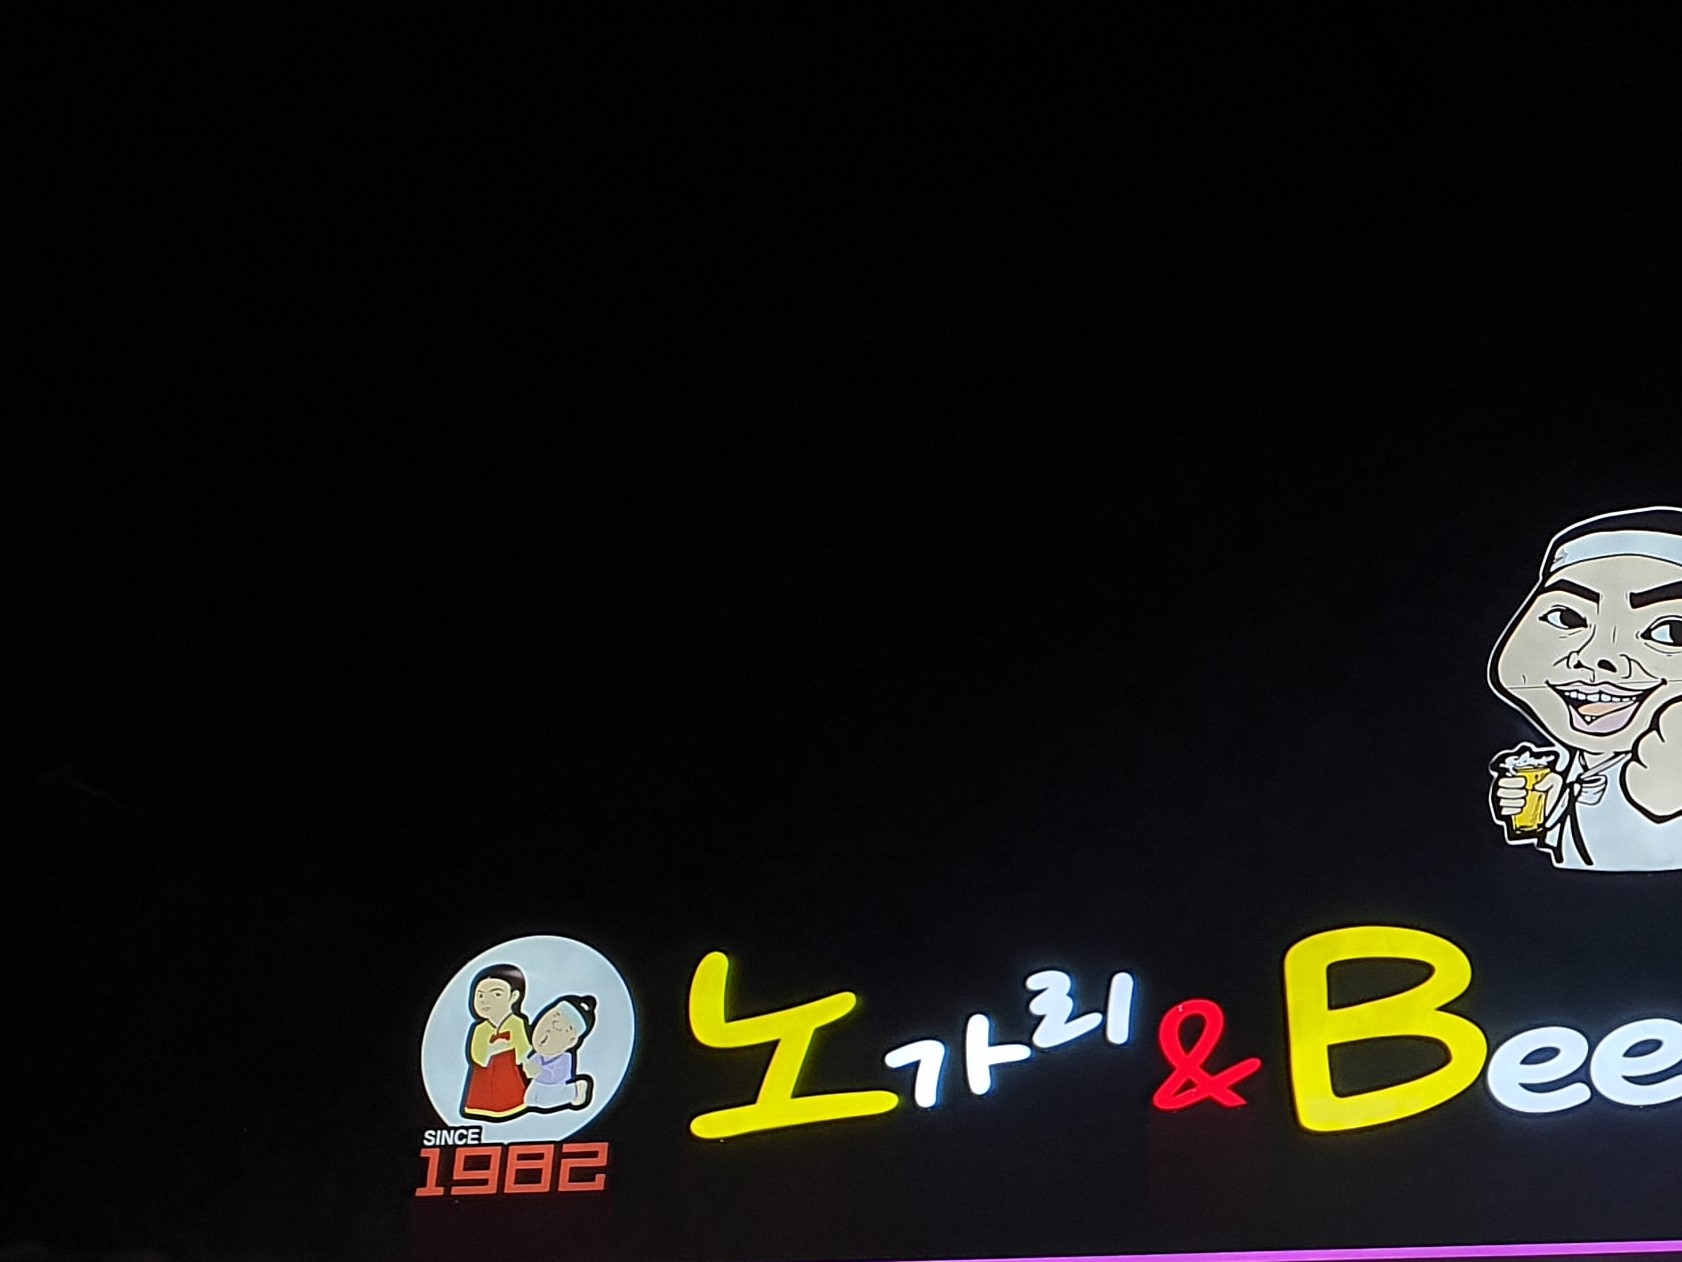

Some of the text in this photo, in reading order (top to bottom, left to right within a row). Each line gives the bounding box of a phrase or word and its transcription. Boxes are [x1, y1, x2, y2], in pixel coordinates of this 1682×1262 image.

[690, 951, 1134, 1139] 노가리
[1153, 999, 1262, 1111] &
[423, 1129, 480, 1146] SINCE
[415, 1142, 609, 1197] 1982
